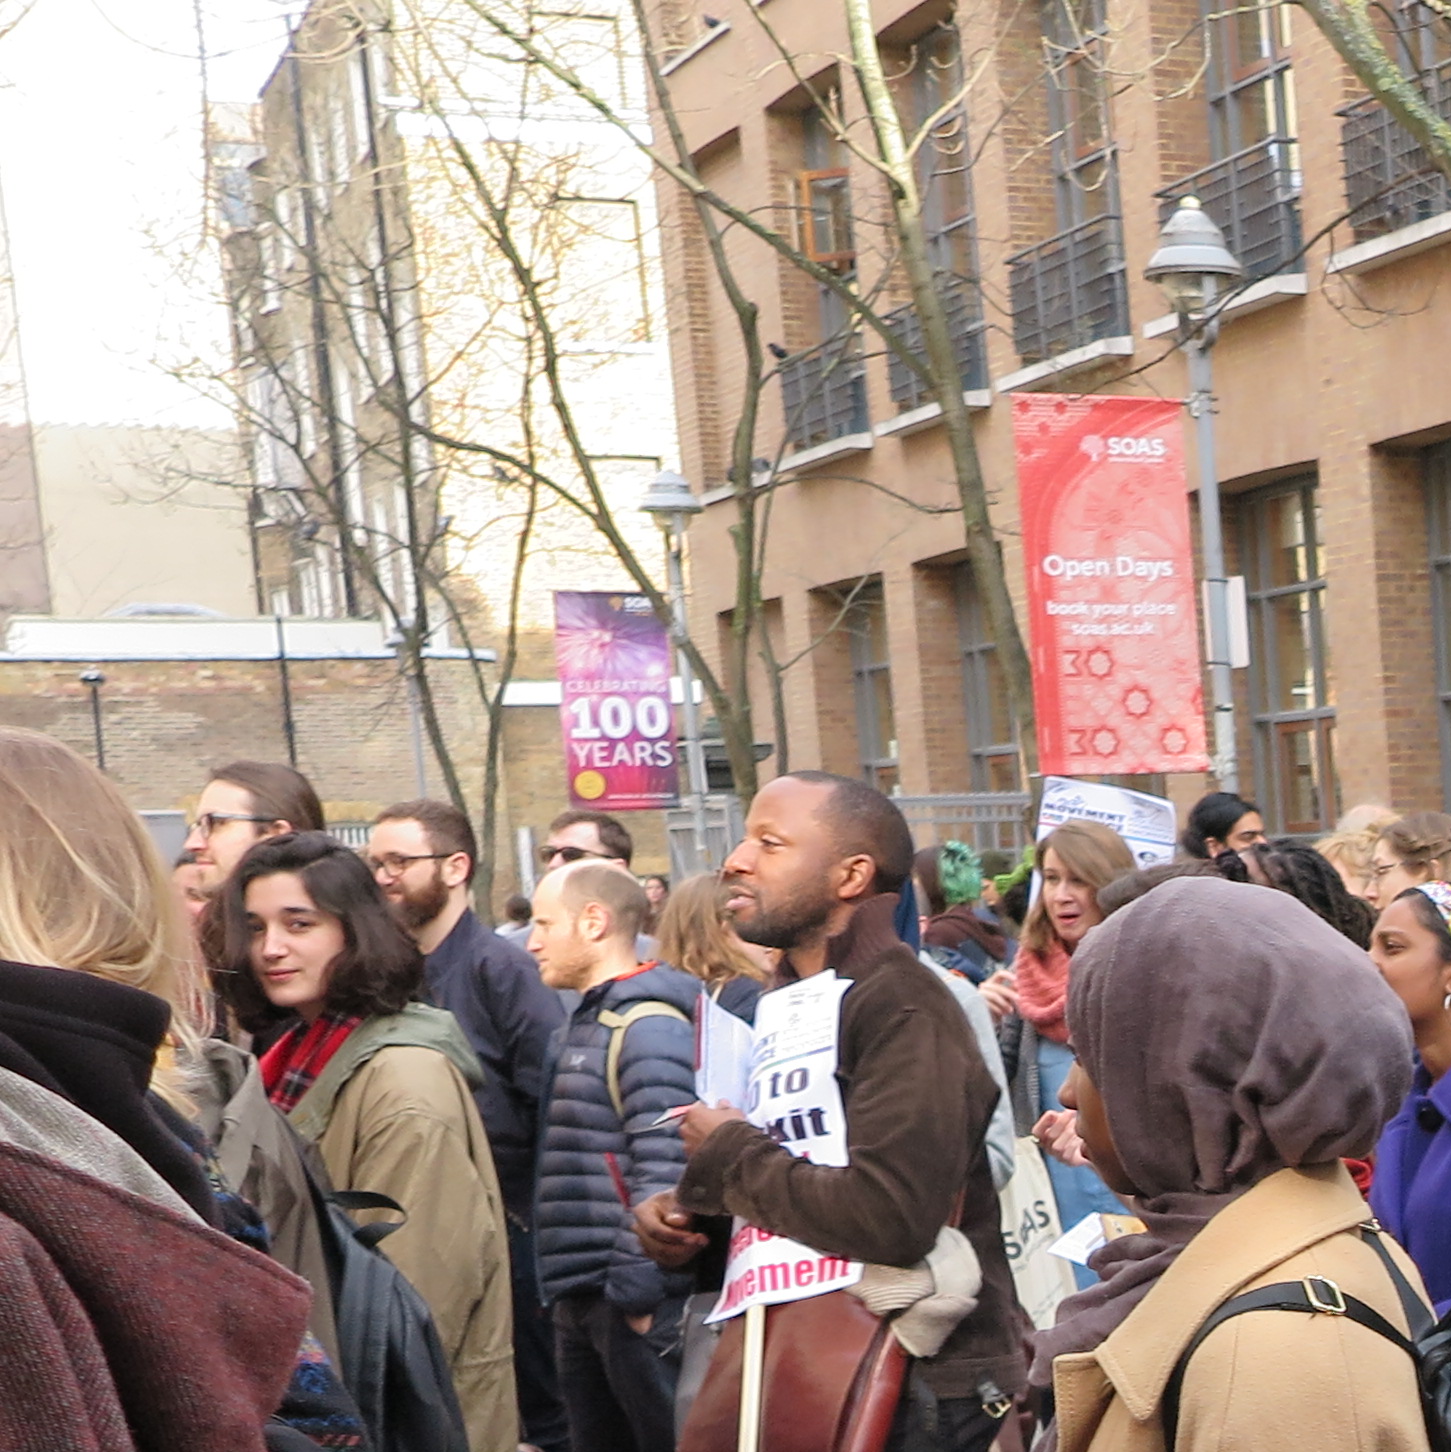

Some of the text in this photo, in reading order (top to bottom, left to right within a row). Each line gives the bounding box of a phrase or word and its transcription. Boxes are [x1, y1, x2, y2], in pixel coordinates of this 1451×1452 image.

[1106, 436, 1166, 456] SOAS
[1042, 555, 1174, 582] Open Days
[624, 596, 653, 609] SOA
[1046, 599, 1177, 618] book your place
[1070, 622, 1156, 636] soas.ac.uk
[566, 678, 667, 693] CELEBRATING
[569, 695, 670, 739] 100
[572, 741, 674, 768] YEARS
[1043, 803, 1127, 823] MOVEMENT
[769, 1067, 809, 1100] to
